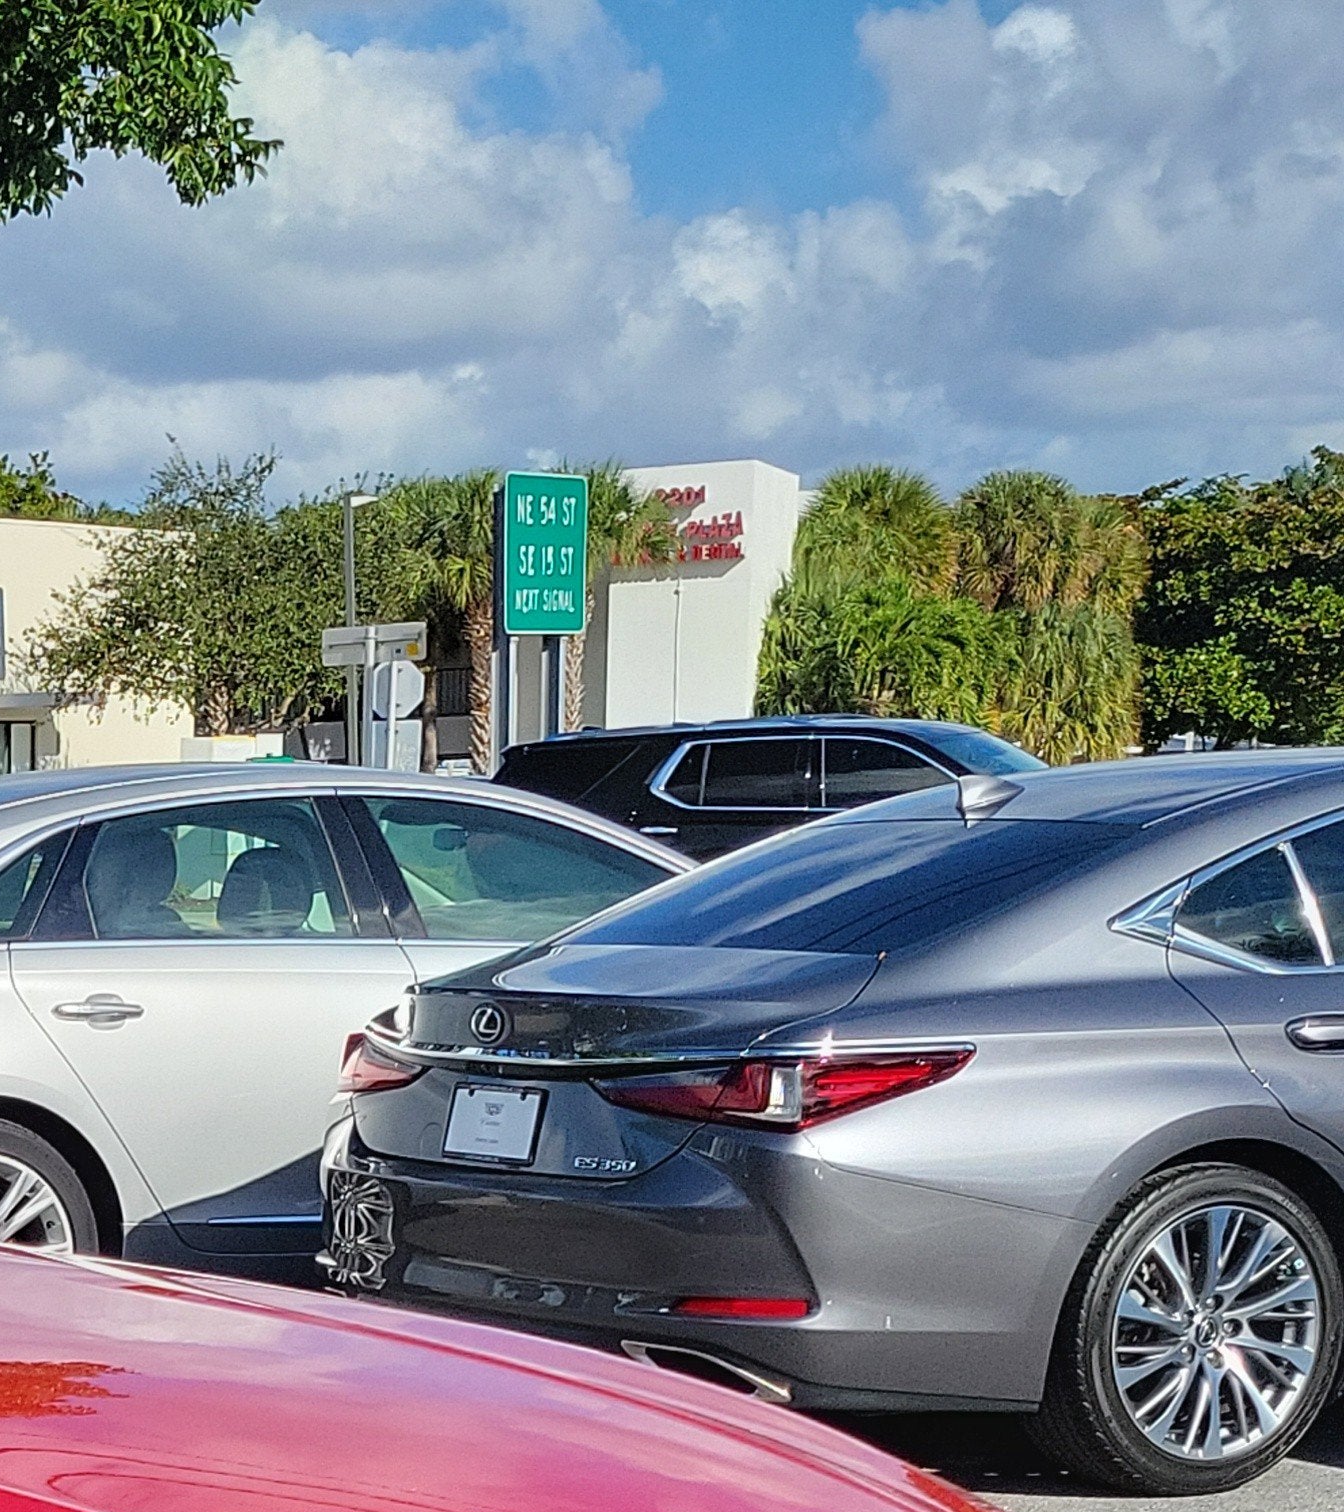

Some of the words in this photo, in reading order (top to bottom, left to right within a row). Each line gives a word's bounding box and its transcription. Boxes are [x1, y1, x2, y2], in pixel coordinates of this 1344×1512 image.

[517, 494, 534, 525] NE
[540, 495, 556, 525] 54
[562, 496, 577, 526] ST
[685, 511, 744, 538] PLAZA
[519, 545, 535, 576] SE
[560, 546, 574, 576] ST
[515, 588, 539, 613] NEXT
[542, 588, 575, 613] SIGNAL
